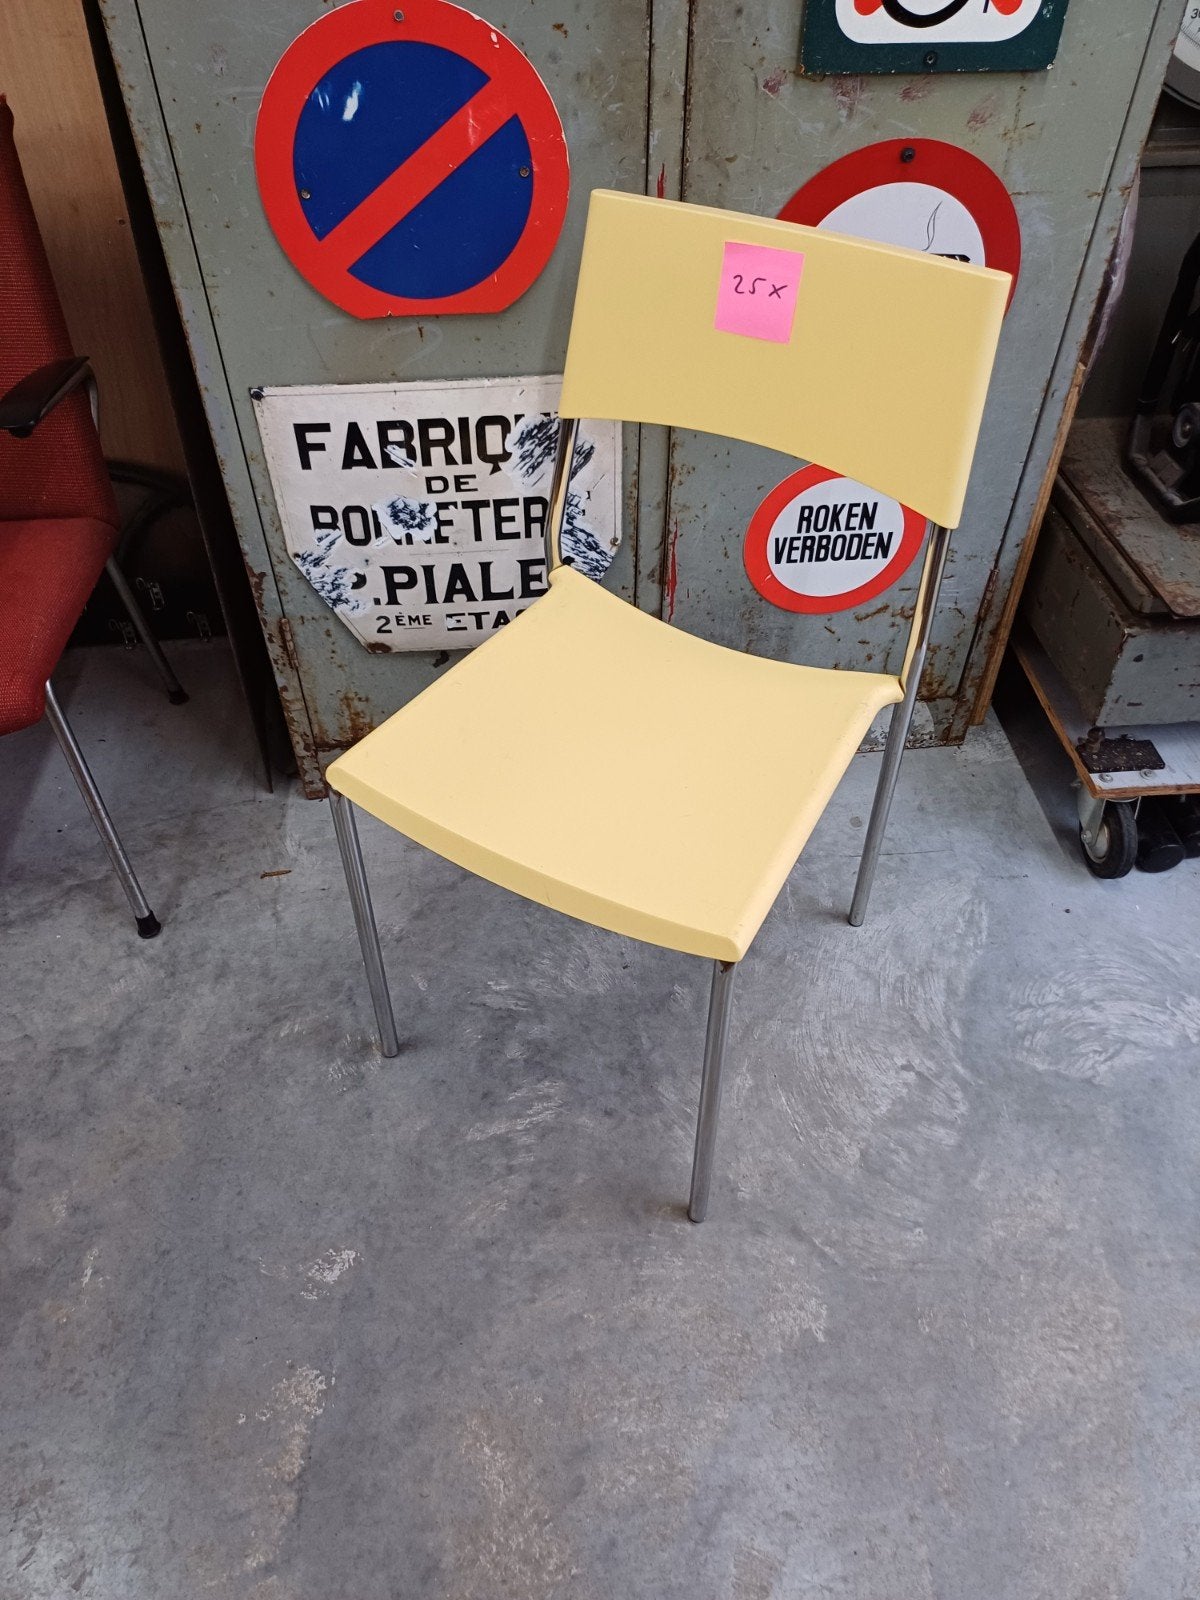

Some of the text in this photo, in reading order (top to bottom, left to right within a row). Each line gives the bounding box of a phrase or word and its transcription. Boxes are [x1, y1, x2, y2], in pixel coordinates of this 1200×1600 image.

[293, 411, 559, 475] FABRIQ
[425, 474, 478, 494] DE
[796, 502, 878, 534] ROKEN
[774, 532, 893, 564] VERBODEN
